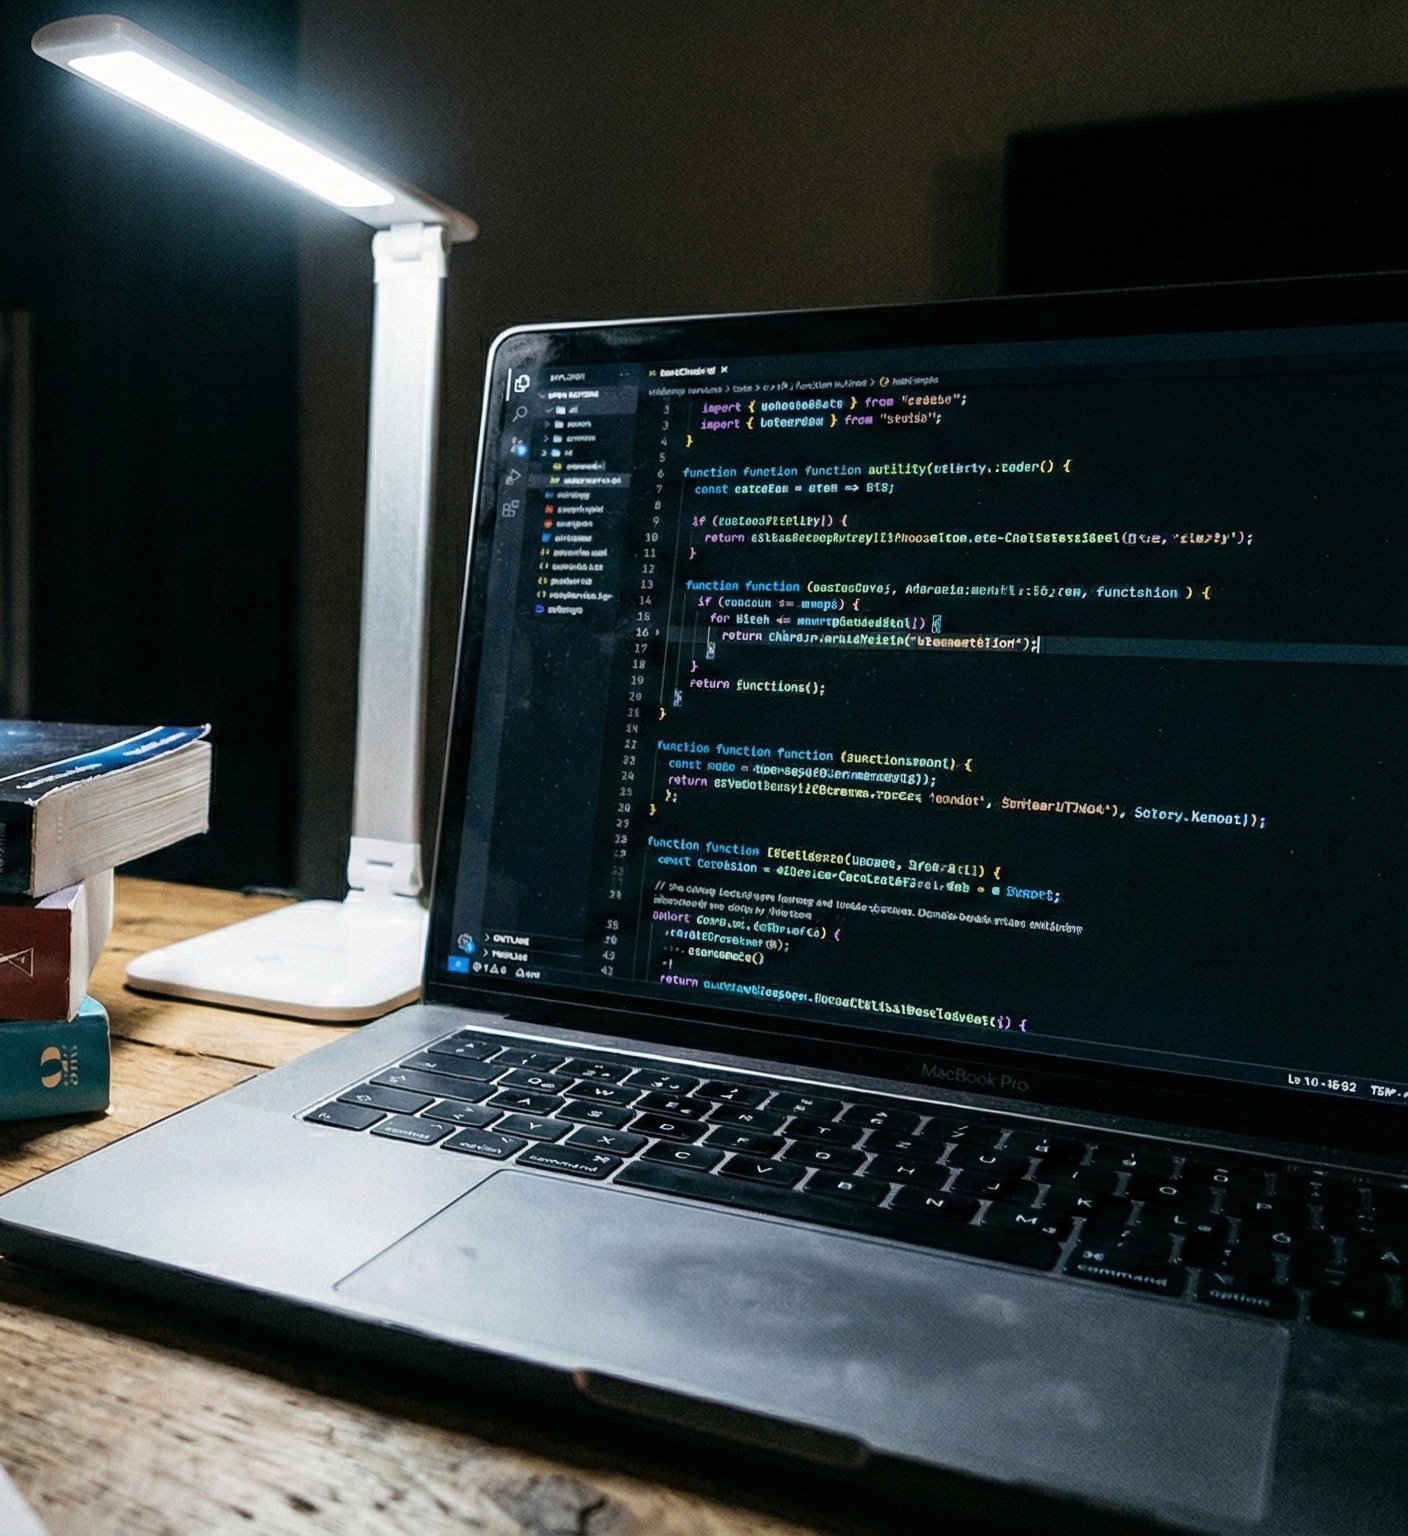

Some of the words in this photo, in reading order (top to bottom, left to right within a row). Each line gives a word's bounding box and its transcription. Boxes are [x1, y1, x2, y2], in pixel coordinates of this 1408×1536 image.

[702, 402, 741, 415] import
[865, 396, 894, 408] from
[701, 417, 741, 431] import
[844, 414, 874, 426] from
[743, 465, 799, 478] function
[805, 465, 862, 477] function
[645, 532, 659, 543] 10
[704, 533, 745, 543] return
[643, 548, 657, 558] 11
[745, 580, 801, 592] function
[710, 613, 731, 624] for
[716, 743, 772, 758] function
[777, 747, 834, 762] function
[668, 774, 708, 787] return
[647, 836, 700, 851] function
[705, 840, 761, 857] function
[921, 1063, 997, 1088] MacBook
[1000, 1075, 1029, 1092] Pro
[1076, 1263, 1169, 1288] command
